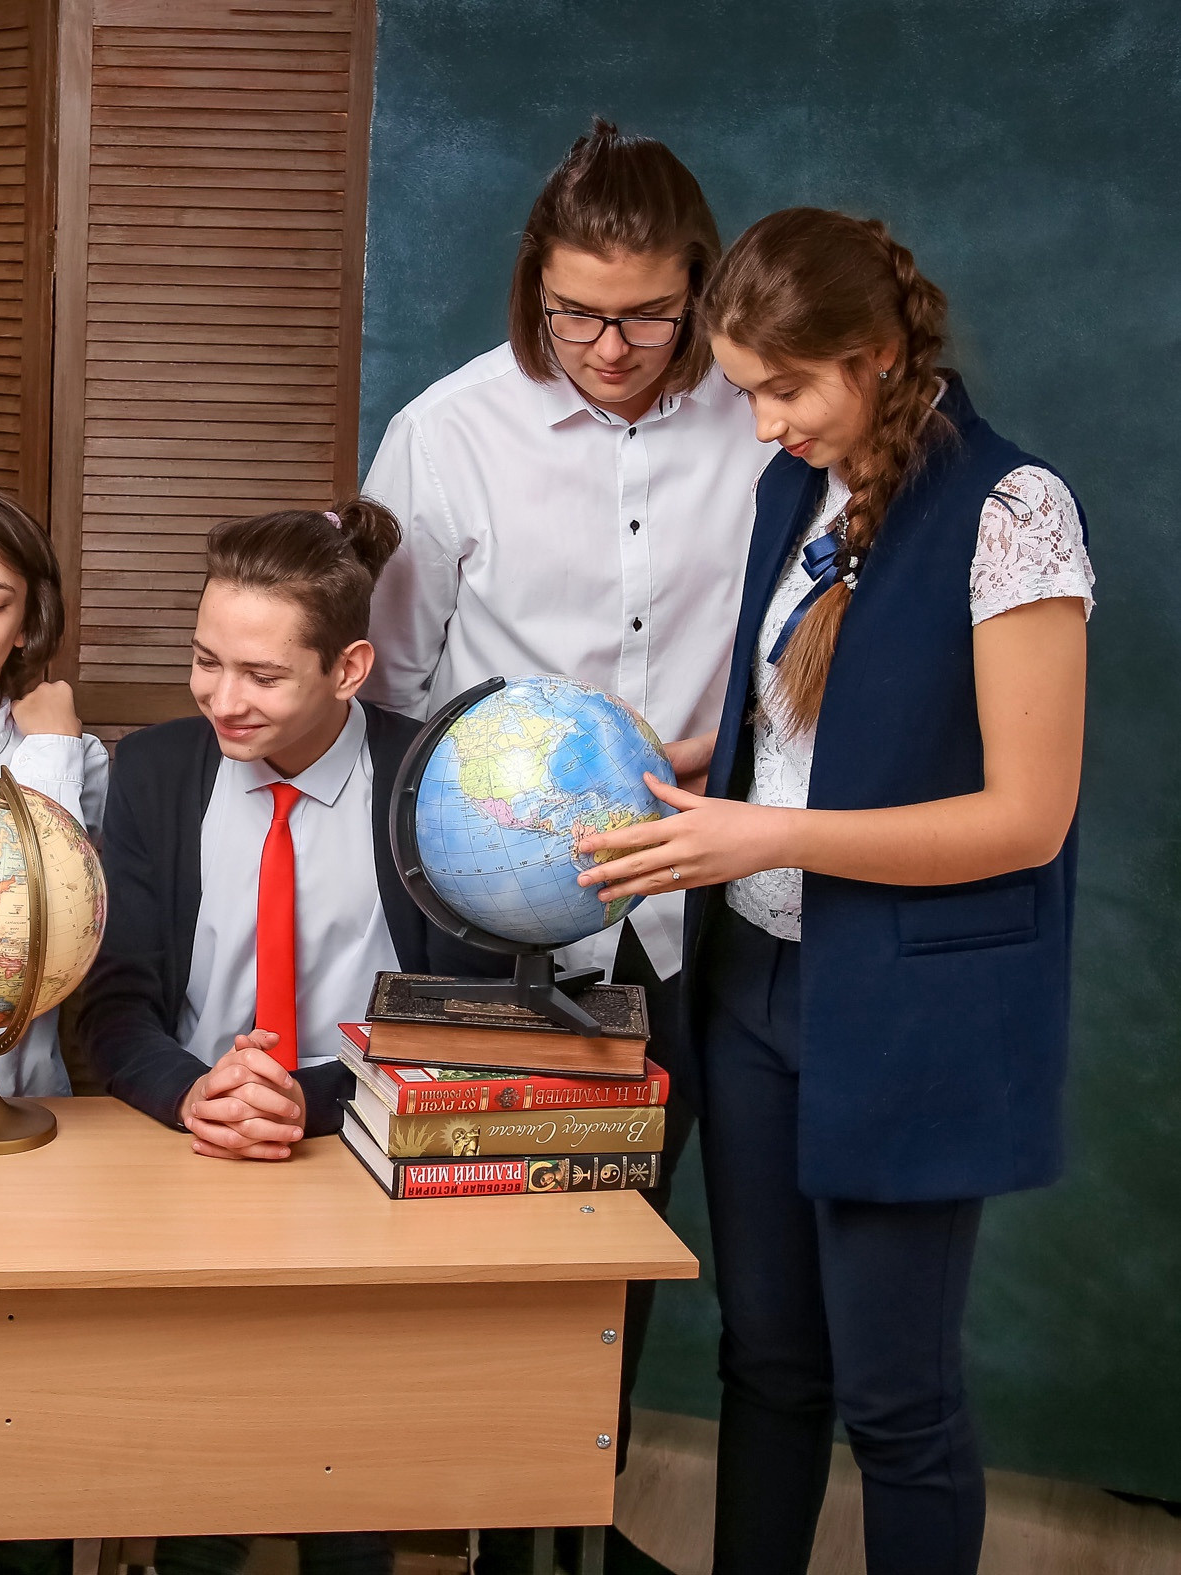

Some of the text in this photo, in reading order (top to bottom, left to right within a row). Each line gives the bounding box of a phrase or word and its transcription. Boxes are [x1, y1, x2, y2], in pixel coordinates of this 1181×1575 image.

[421, 1086, 478, 1100] ДО РОССИИ
[535, 1086, 648, 1105] Л. Н. ГУМИЛЕВ
[419, 1099, 477, 1112] ОТ РУСИ
[486, 1114, 648, 1148] В поисках Смысла
[409, 1163, 522, 1186] РЕЛИГИЙ МИРА
[408, 1182, 522, 1196] ВСЕОБЩАЯ ИСТОРИЯ
